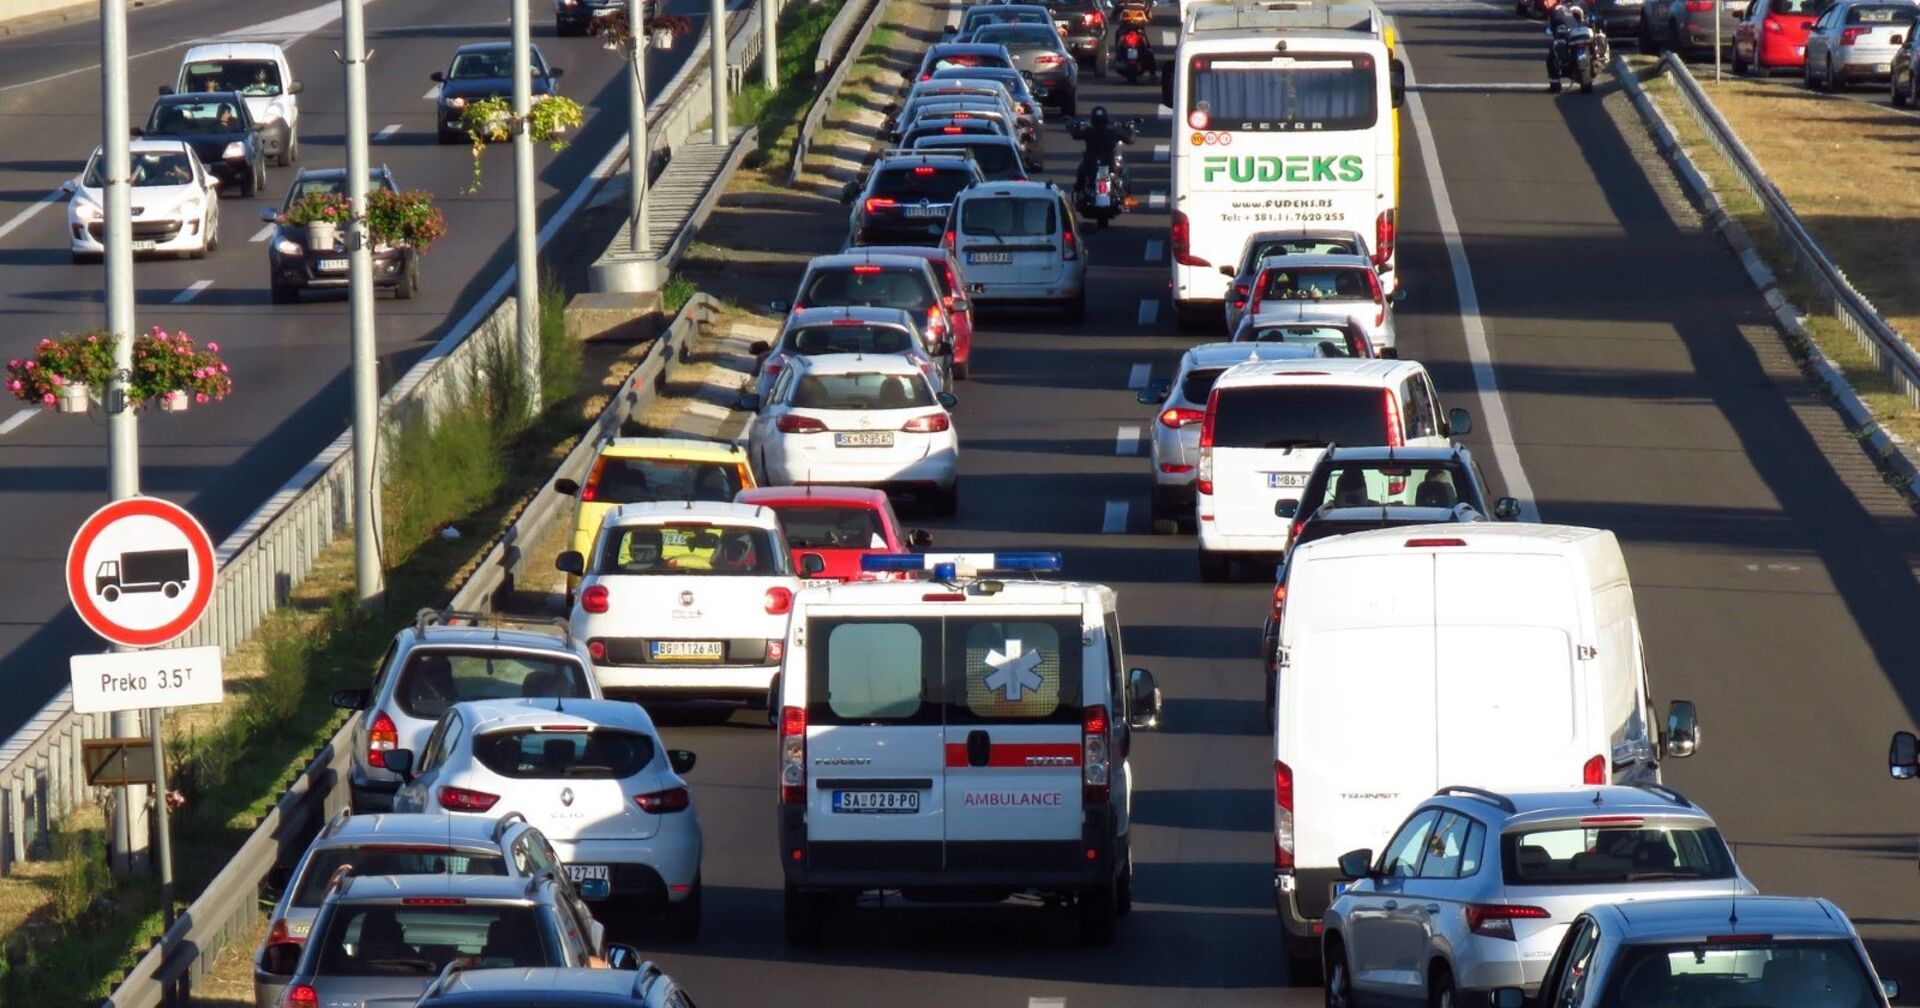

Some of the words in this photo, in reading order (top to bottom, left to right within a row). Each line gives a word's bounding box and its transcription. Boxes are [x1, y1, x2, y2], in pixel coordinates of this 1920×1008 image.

[1241, 122, 1323, 130] SETRA
[1203, 154, 1364, 183] FUDEKS
[659, 643, 673, 654] BG
[101, 673, 147, 692] Preko
[843, 792, 860, 807] SA
[964, 792, 1062, 806] AMBULANCE
